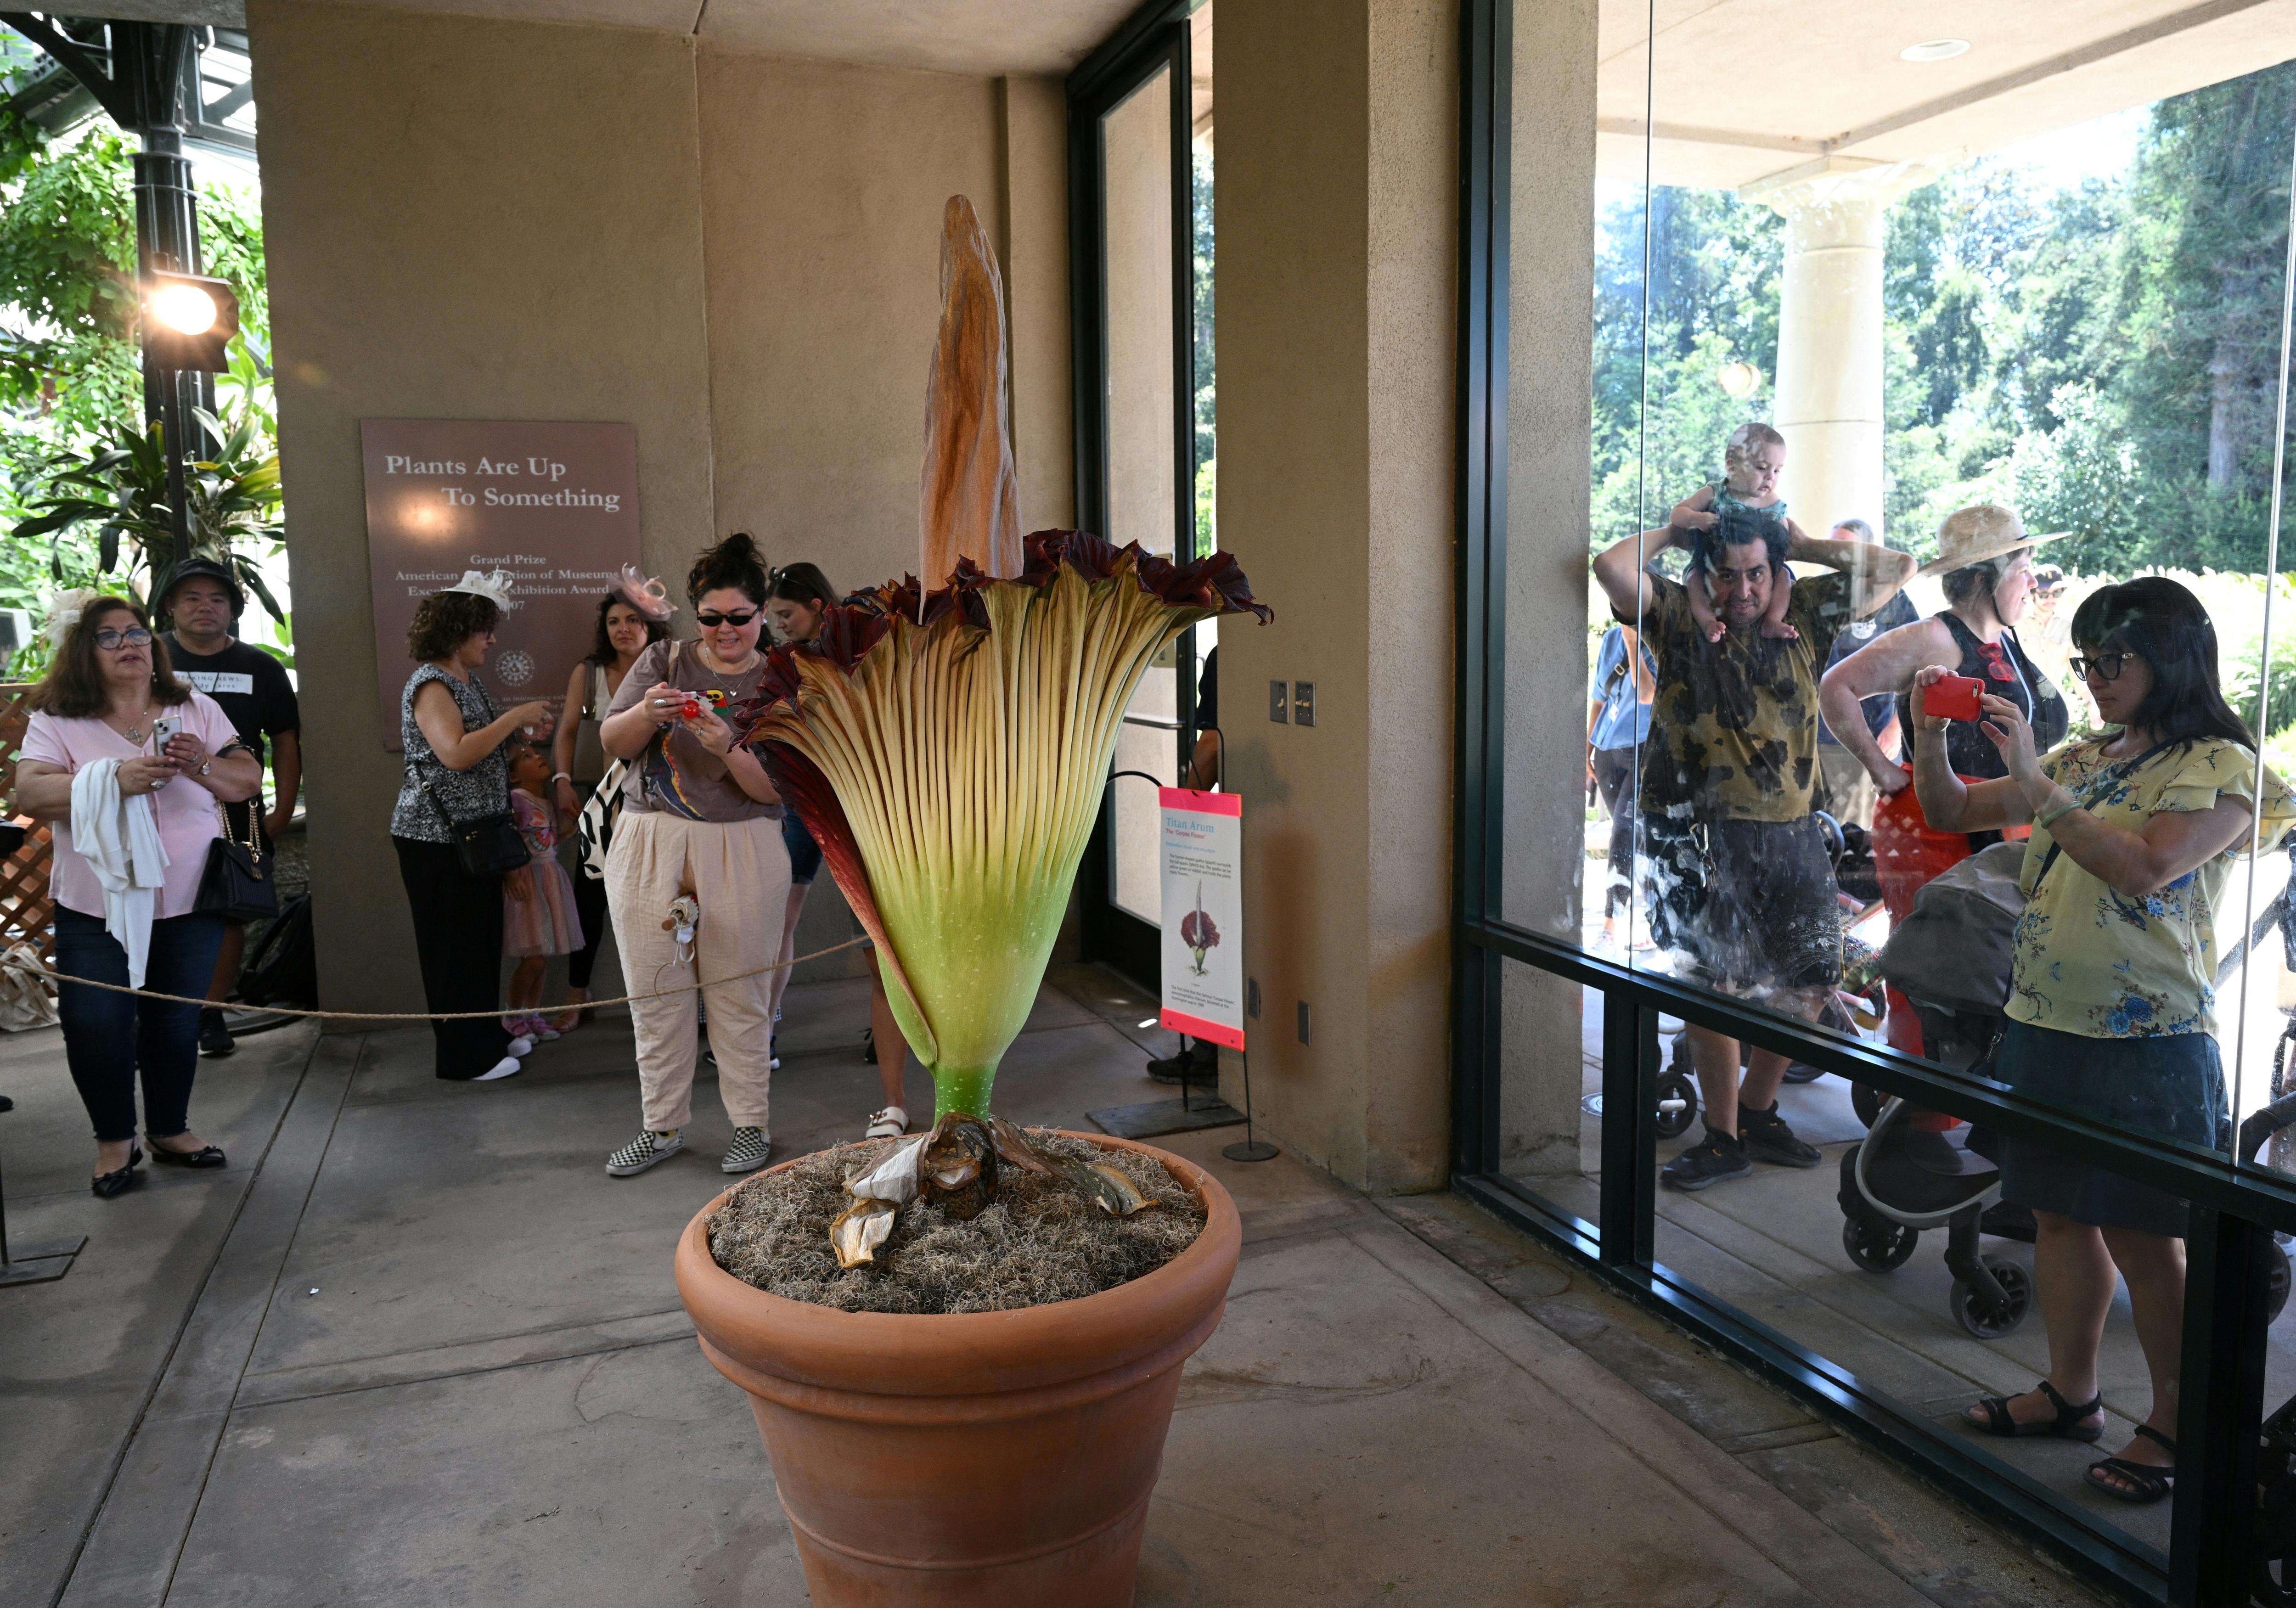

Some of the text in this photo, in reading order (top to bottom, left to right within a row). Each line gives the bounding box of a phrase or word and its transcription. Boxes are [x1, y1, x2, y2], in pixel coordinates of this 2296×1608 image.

[385, 455, 566, 482] Plants Are Up
[441, 487, 620, 513] To Something
[470, 554, 546, 565] Grand Prize
[395, 570, 458, 581] American
[540, 569, 554, 579] of
[558, 569, 619, 579] Museums
[507, 584, 609, 595] xhibition Award
[1166, 817, 1215, 833] Titan Arum
